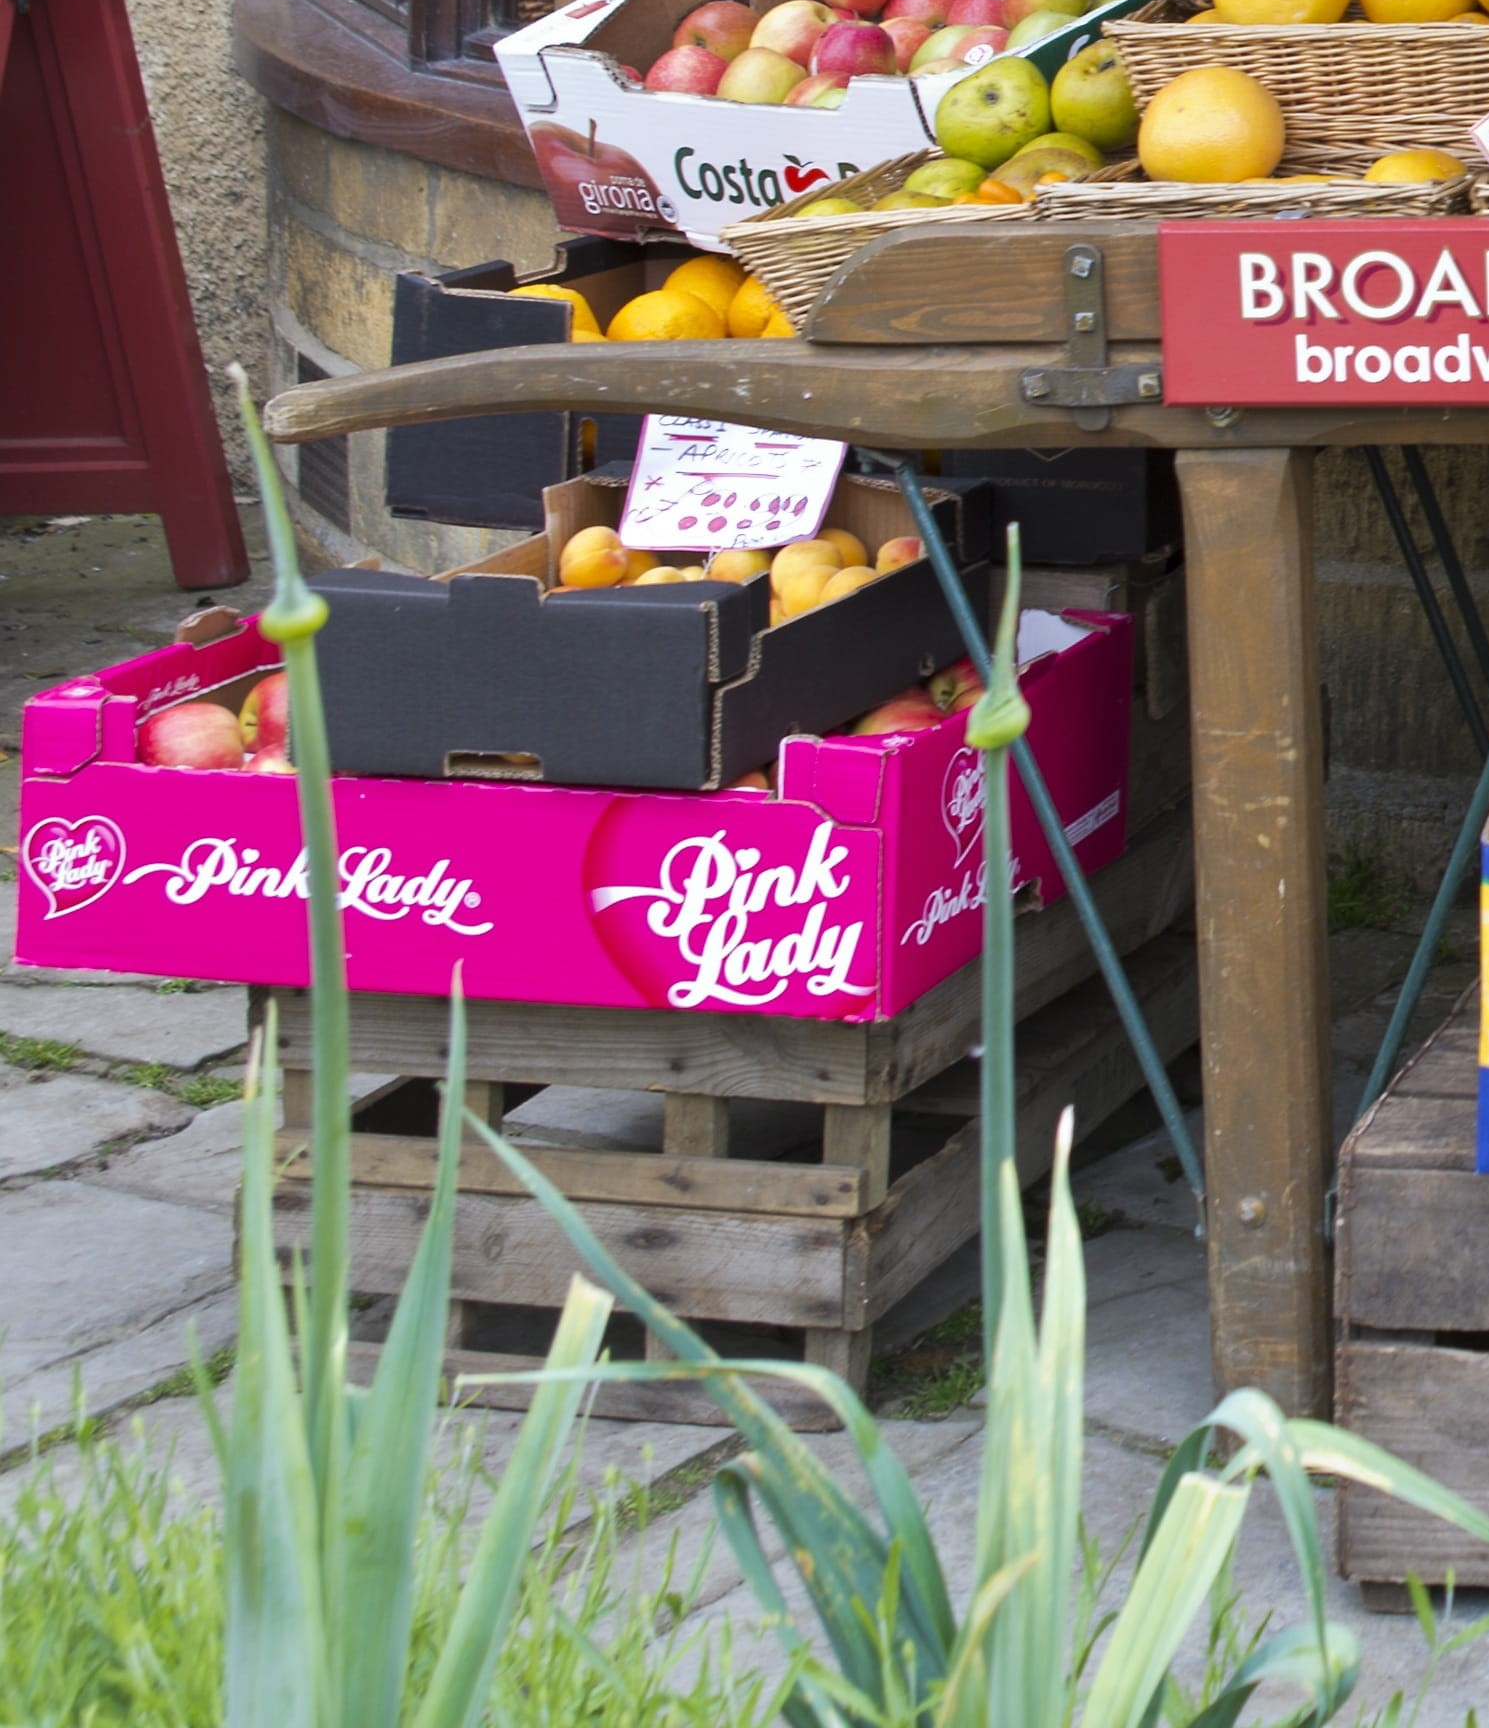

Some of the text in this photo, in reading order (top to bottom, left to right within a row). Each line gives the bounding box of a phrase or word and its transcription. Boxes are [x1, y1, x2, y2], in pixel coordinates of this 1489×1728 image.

[578, 179, 655, 215] girona
[674, 146, 783, 208] Costa
[32, 828, 102, 873] Pink
[50, 852, 113, 891] Lady
[123, 837, 312, 905] Pink
[591, 819, 851, 938] Pink
[901, 869, 973, 946] Pink
[667, 901, 876, 1009] Lady
